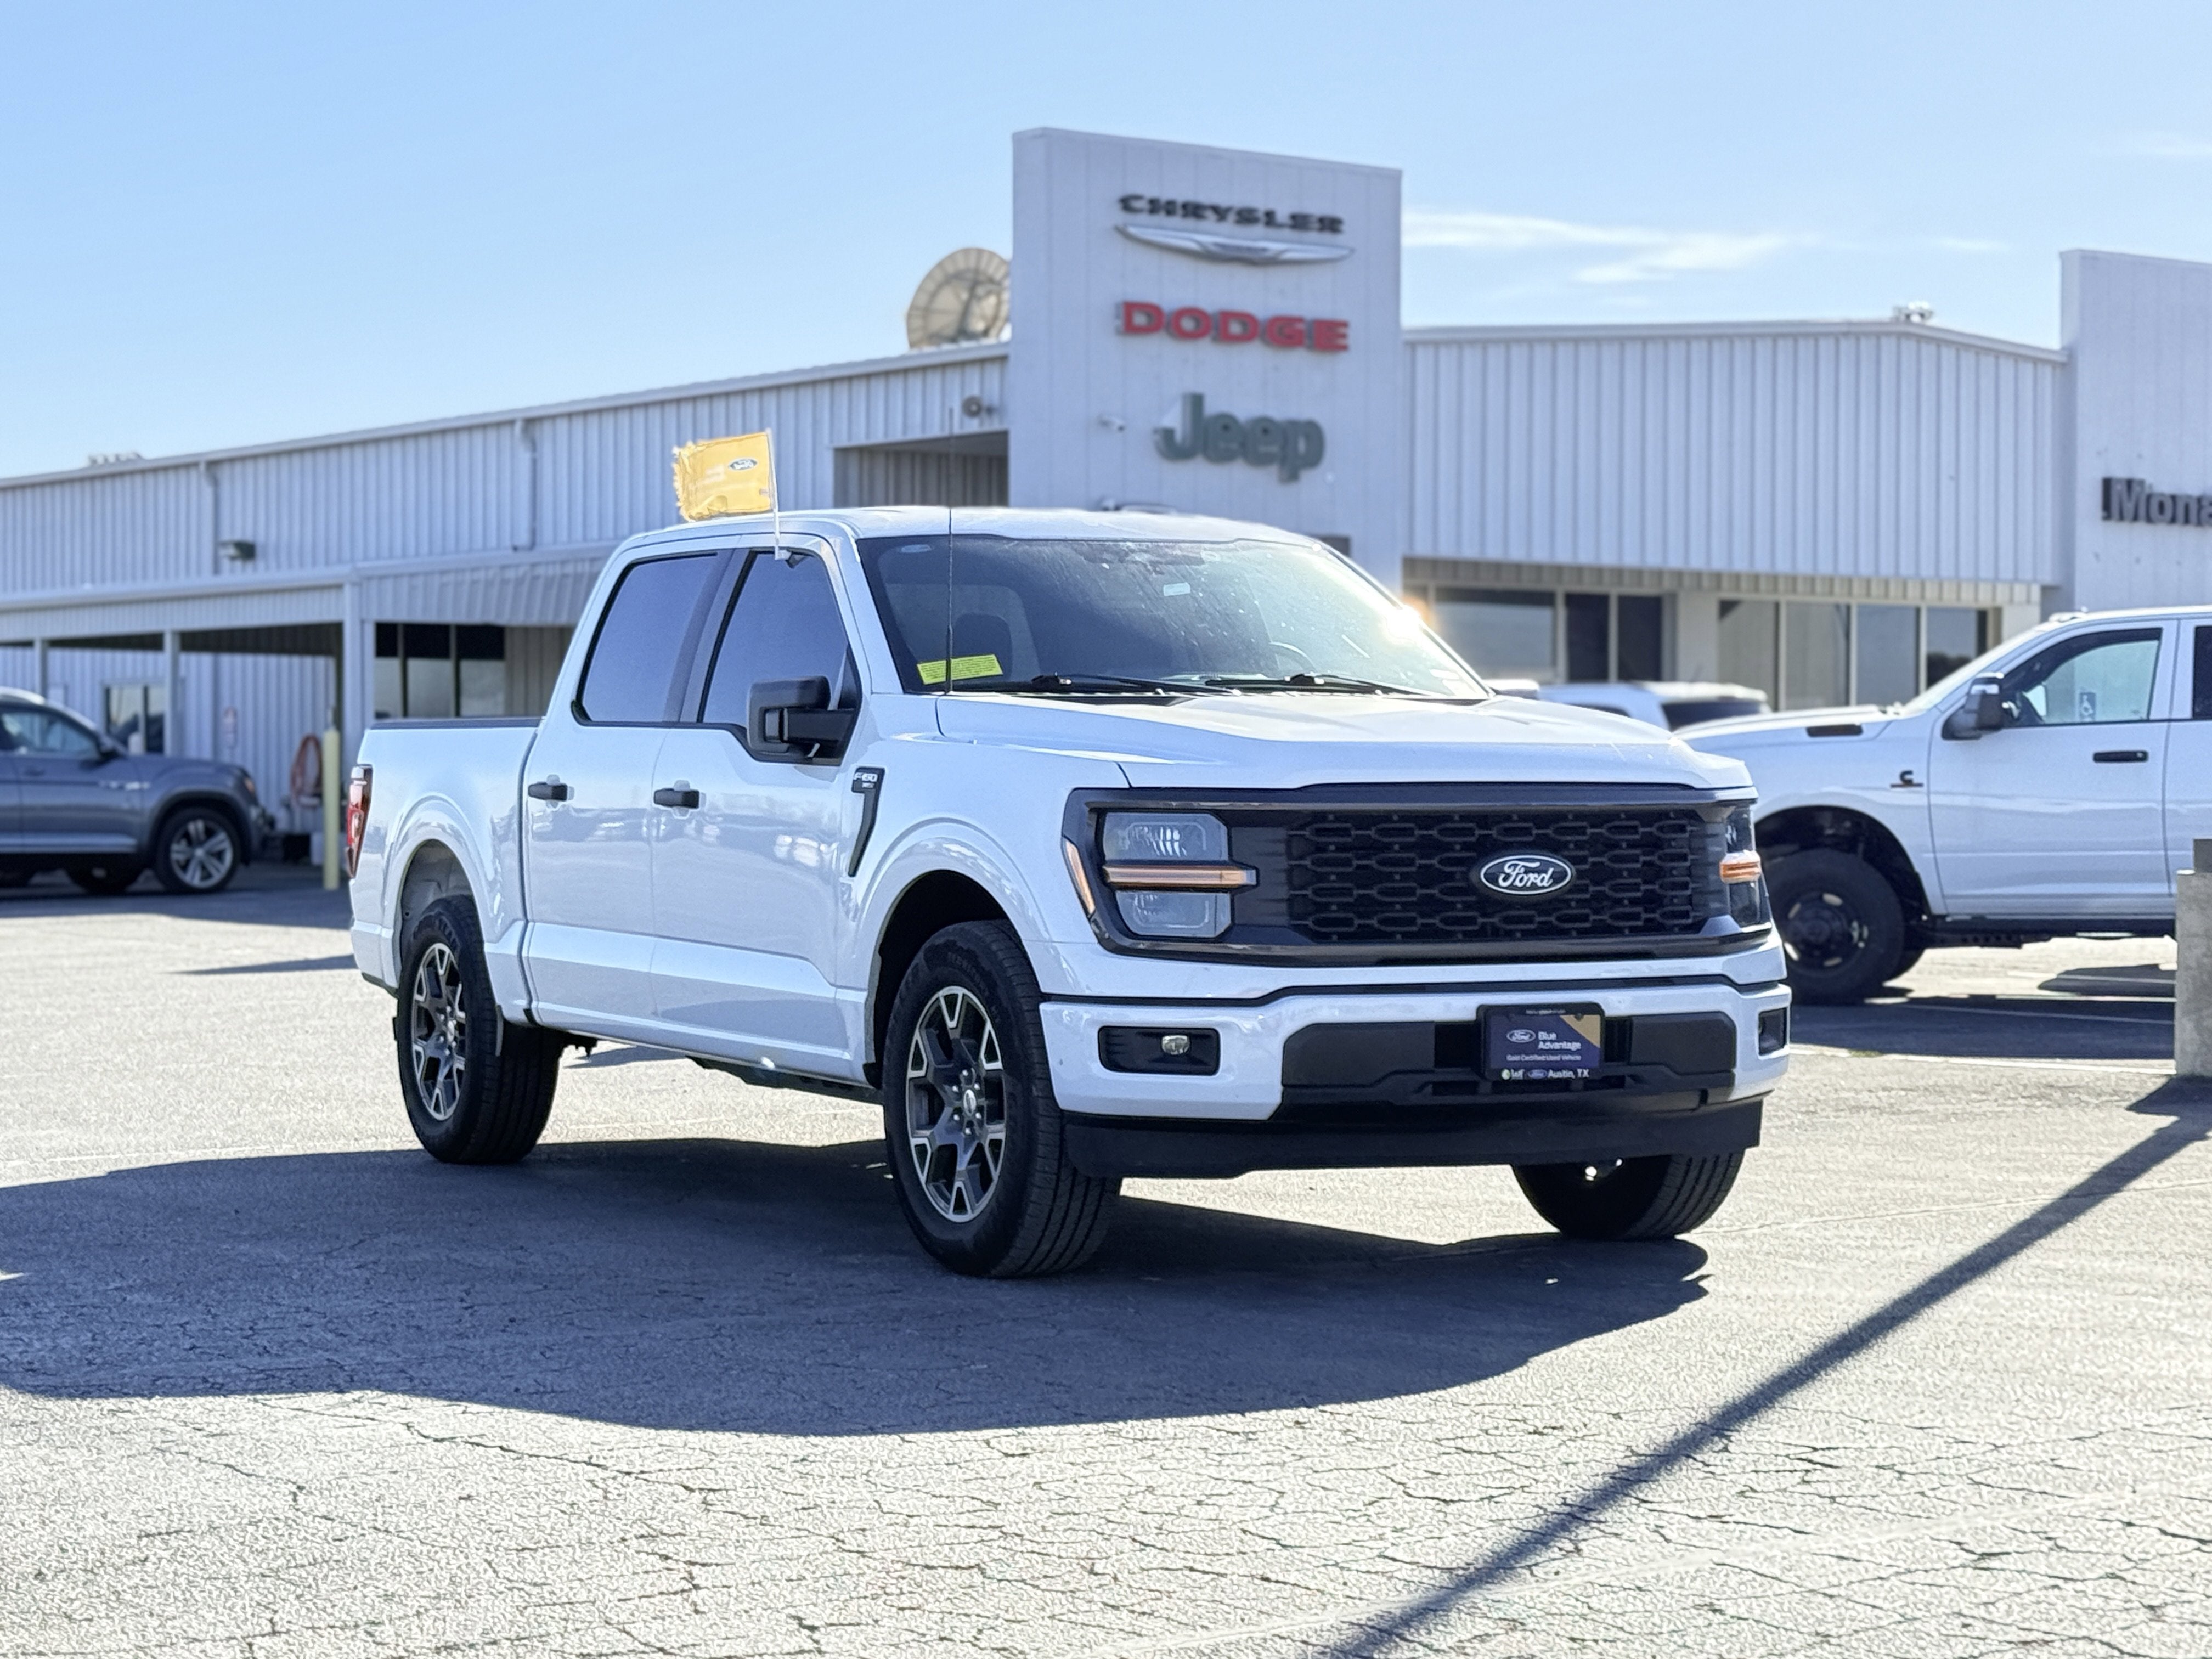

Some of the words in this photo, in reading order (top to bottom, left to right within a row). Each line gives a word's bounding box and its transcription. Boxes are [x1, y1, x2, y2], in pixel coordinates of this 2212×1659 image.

[1118, 194, 1344, 234] CHRYSLER
[1117, 300, 1350, 353] DODGE
[1153, 392, 1325, 484] Jeep
[1498, 860, 1554, 888] Ford
[1538, 1031, 1557, 1041] Blue
[1538, 1041, 1582, 1051] Advantage
[1548, 1069, 1575, 1079] Austin,
[1577, 1069, 1589, 1078] TX
